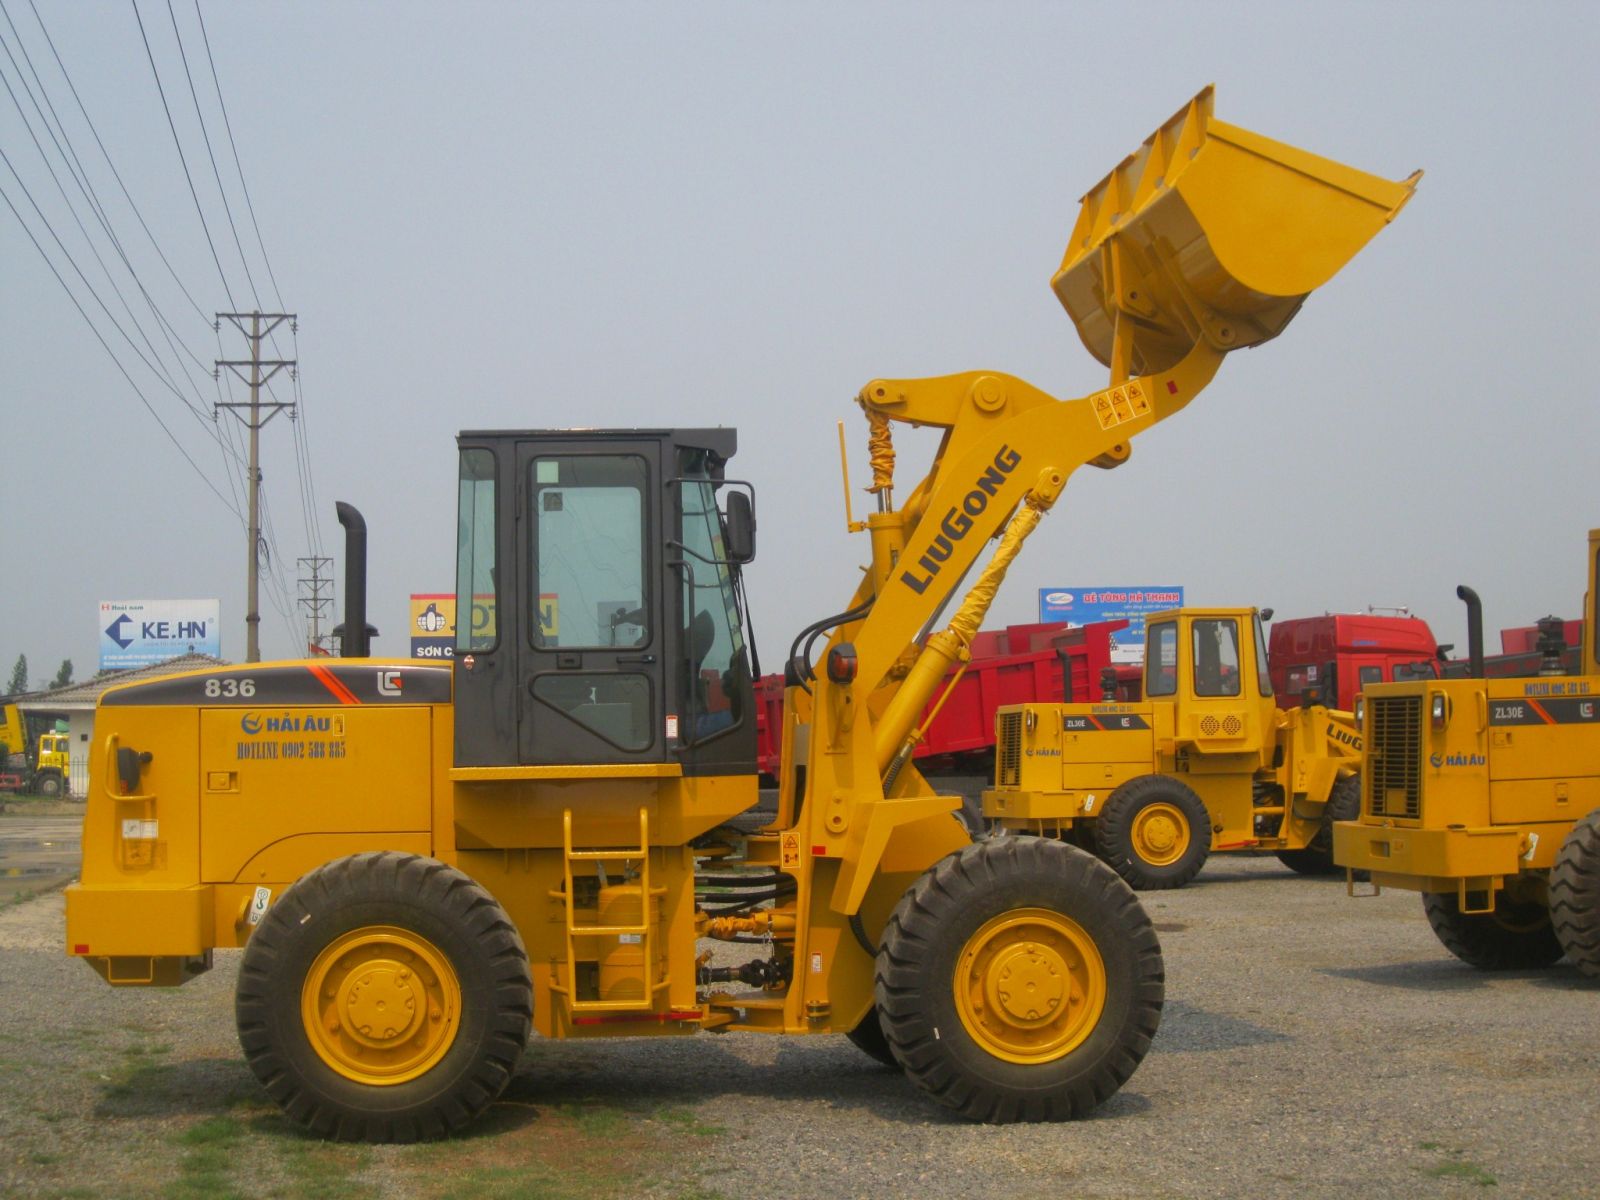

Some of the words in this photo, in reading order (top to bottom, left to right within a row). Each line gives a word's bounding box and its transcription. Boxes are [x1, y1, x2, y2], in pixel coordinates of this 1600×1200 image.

[900, 444, 1022, 595] LIUGONG
[142, 621, 206, 639] KE.HN
[416, 645, 442, 657] SƠN
[204, 678, 256, 698] 836
[266, 712, 300, 732] HẢI
[303, 714, 331, 732] ÂU
[1495, 706, 1524, 719] ZL30E
[236, 741, 279, 760] HOTLINE
[282, 742, 305, 759] 0902
[308, 741, 326, 759] 588
